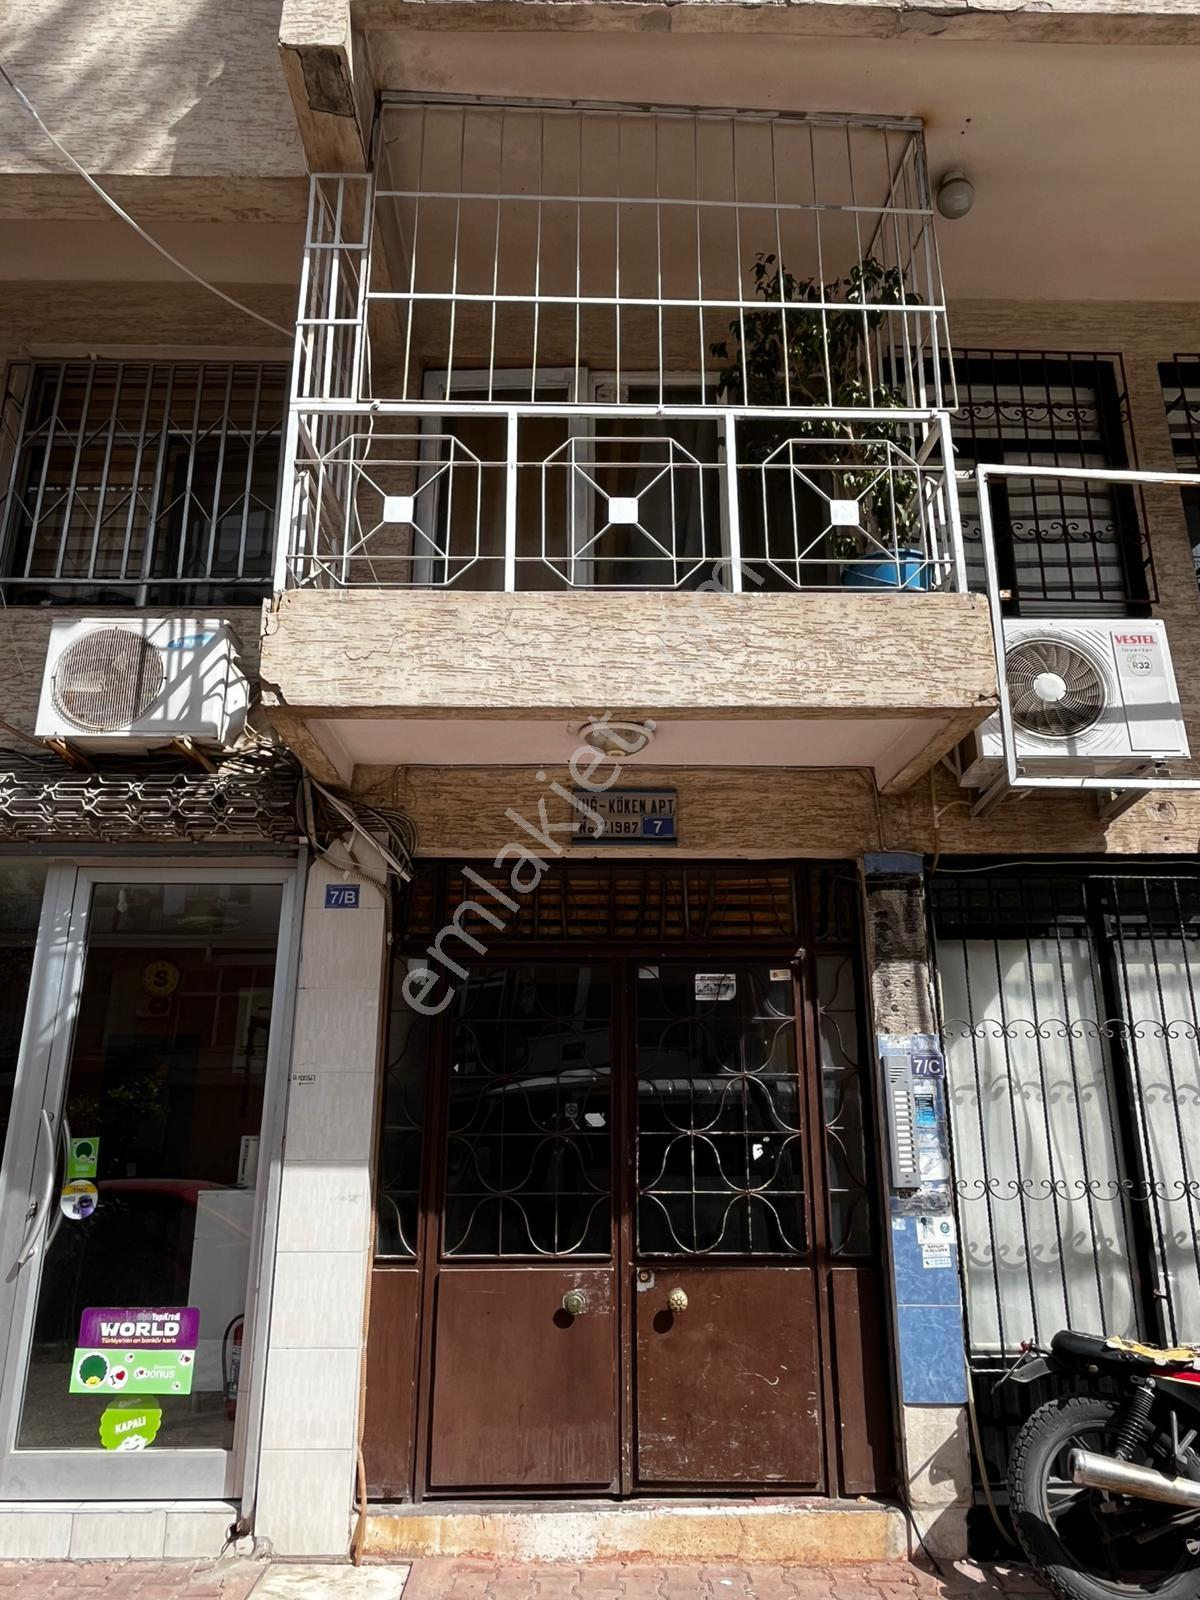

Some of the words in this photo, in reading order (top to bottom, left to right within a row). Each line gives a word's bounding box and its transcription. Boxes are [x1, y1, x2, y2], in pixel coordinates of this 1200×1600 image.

[1114, 634, 1157, 645] VESTEL
[1132, 661, 1151, 670] R32
[653, 820, 663, 834] 7
[330, 890, 356, 905] 7/B
[913, 1059, 941, 1074] 7/C
[100, 1322, 180, 1337] WORLD
[114, 1416, 147, 1435] KAPALI
